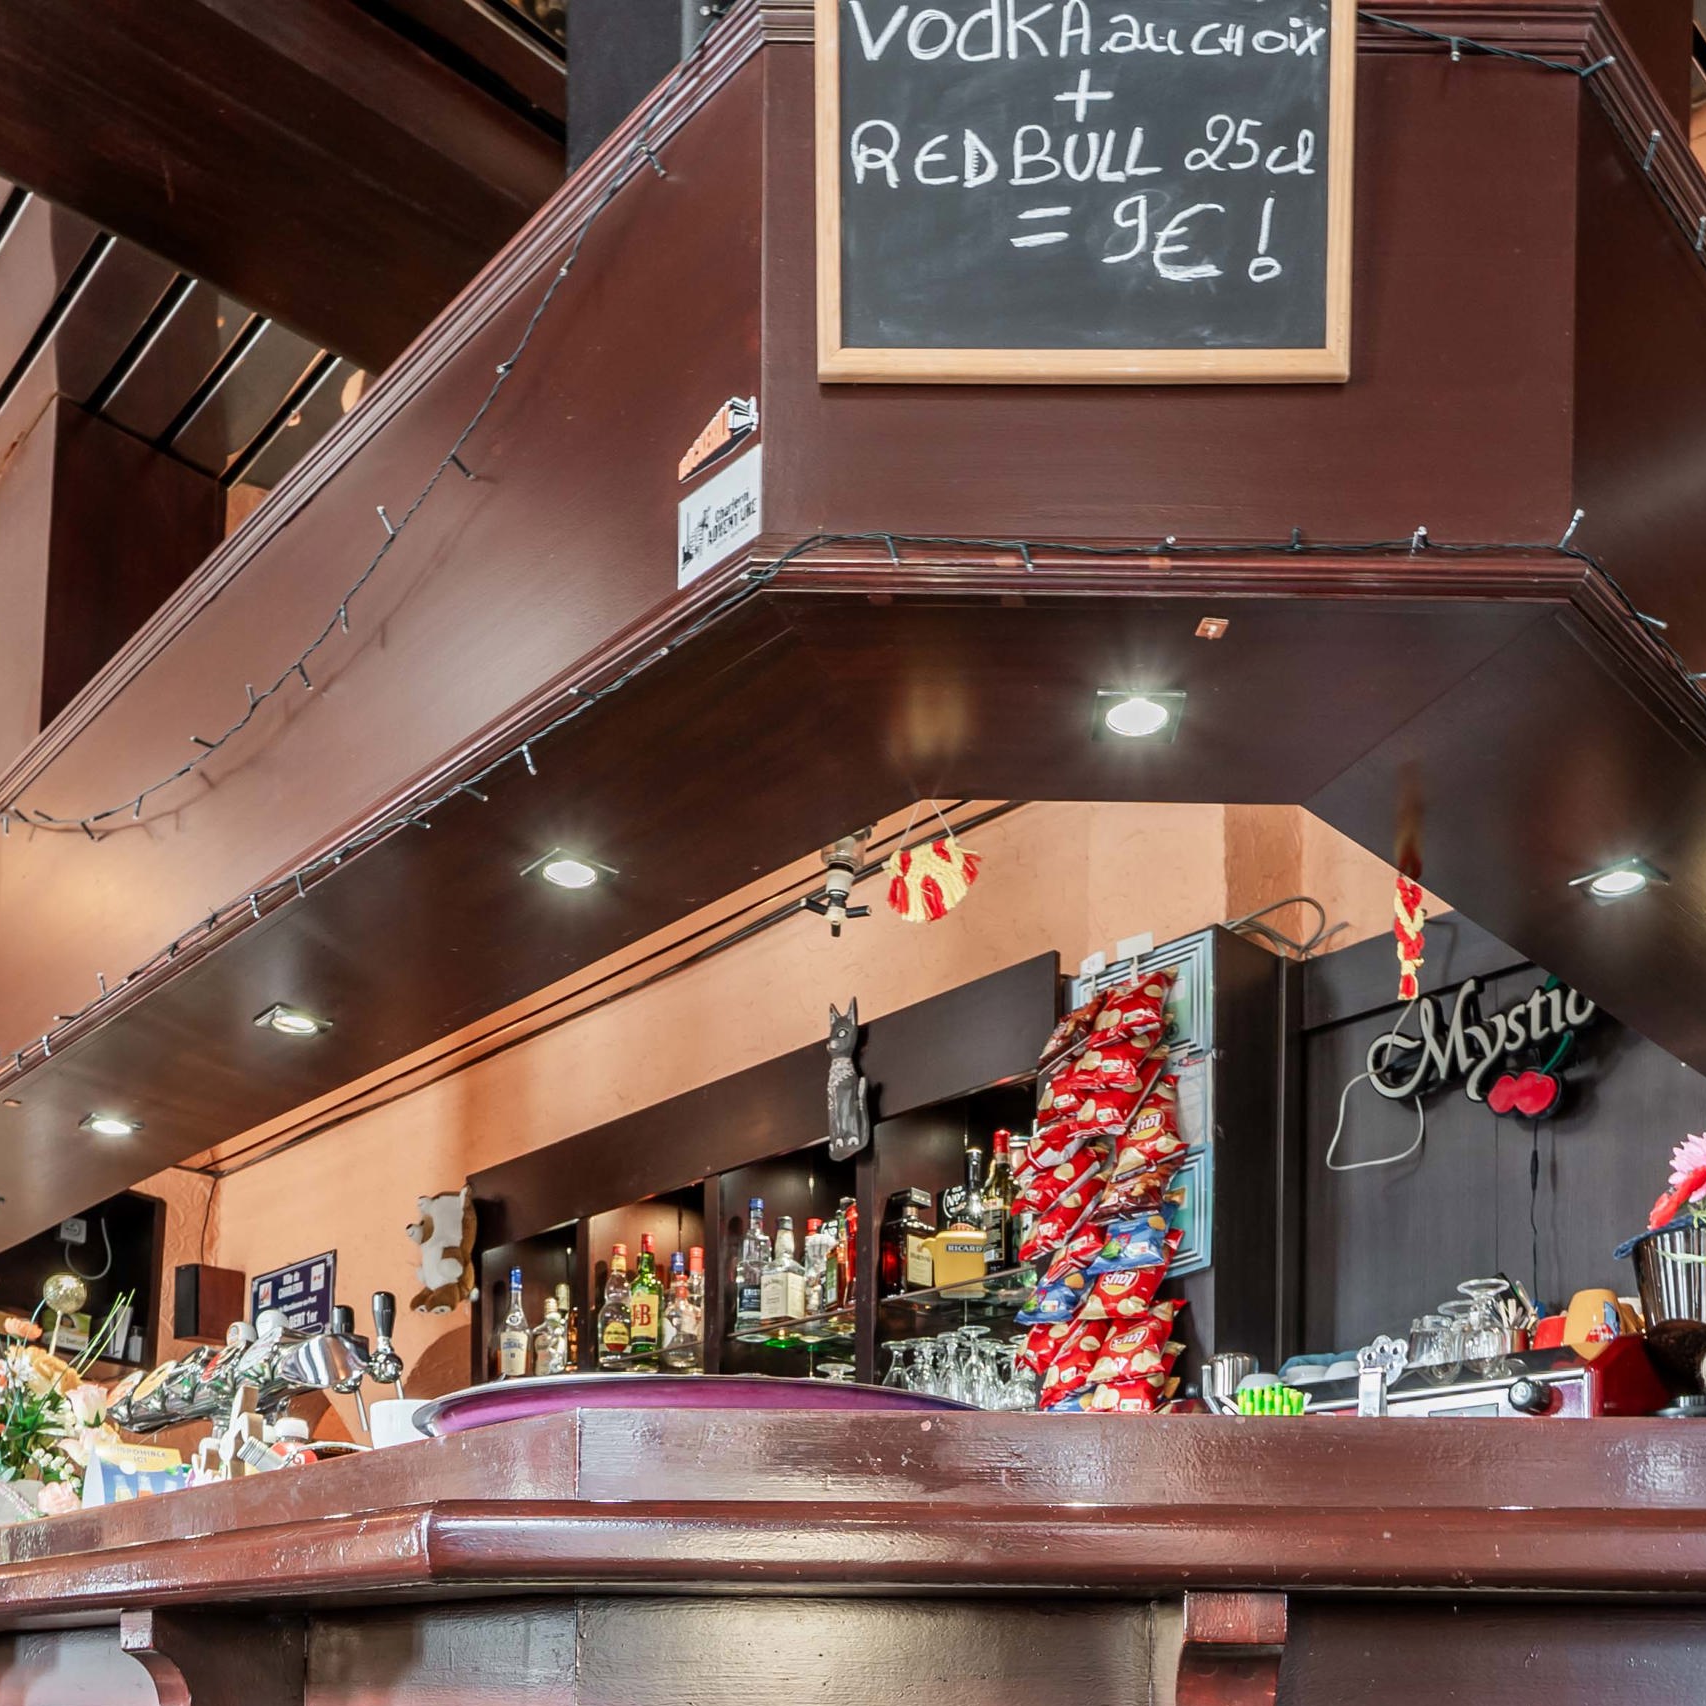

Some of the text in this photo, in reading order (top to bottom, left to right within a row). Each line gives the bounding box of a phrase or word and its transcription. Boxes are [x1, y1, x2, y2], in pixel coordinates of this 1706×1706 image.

[1008, 124, 1163, 186] BULL
[1367, 977, 1595, 1101] Mystic
[947, 1244, 983, 1252] RICARD
